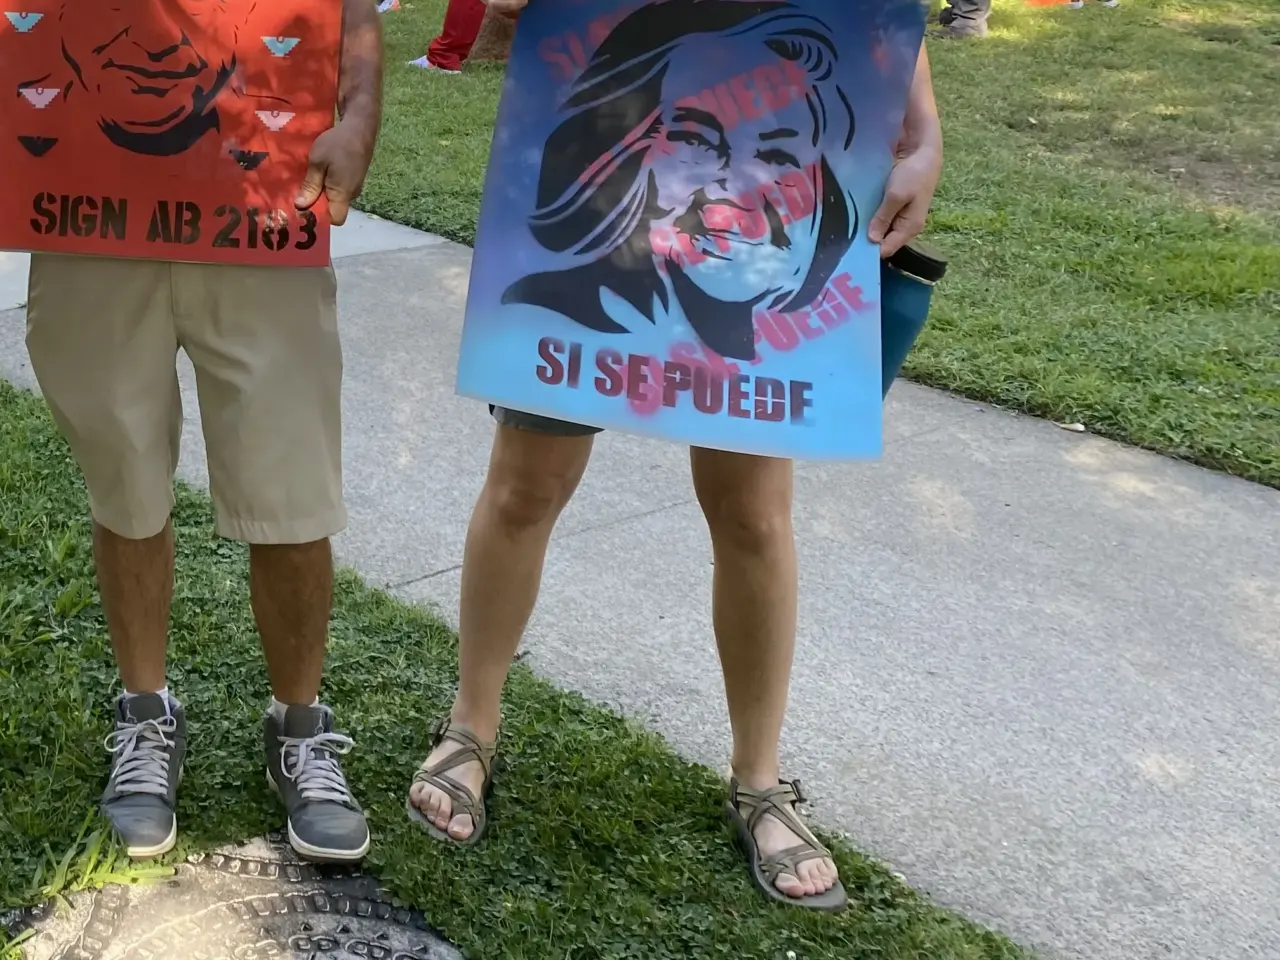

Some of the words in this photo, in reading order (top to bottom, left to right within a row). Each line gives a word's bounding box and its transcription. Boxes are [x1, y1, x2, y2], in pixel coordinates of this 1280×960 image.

[30, 191, 128, 240] SIGN
[145, 200, 202, 245] AB
[536, 336, 583, 389] SI
[594, 349, 650, 401] SE
